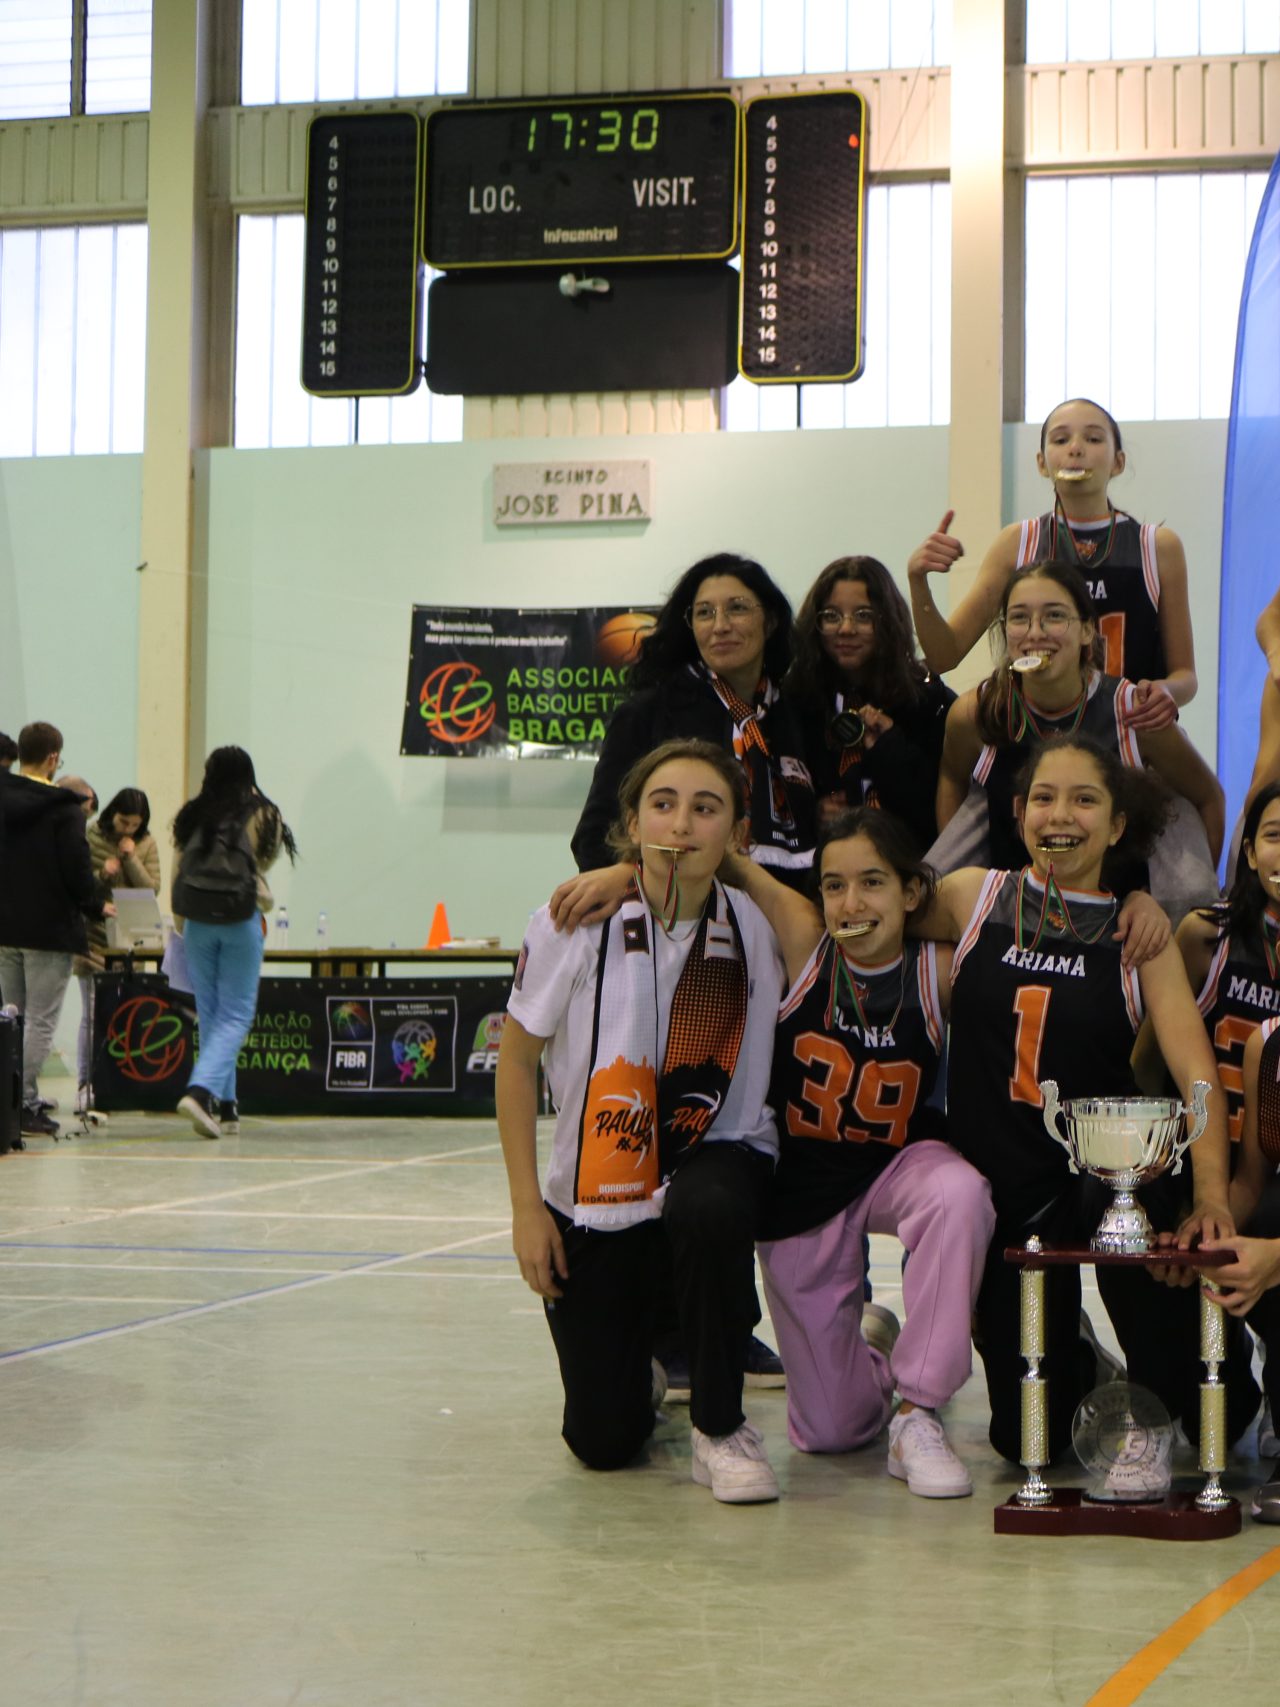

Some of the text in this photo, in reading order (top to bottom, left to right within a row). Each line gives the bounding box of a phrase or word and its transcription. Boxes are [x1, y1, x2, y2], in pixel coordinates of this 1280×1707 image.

[766, 115, 777, 130] 4
[528, 110, 659, 152] 17:30
[329, 136, 338, 149] 4
[766, 136, 777, 152] 5
[329, 156, 338, 170] 5
[765, 157, 776, 173] 6
[328, 176, 337, 190] 6
[765, 178, 776, 194] 7
[469, 185, 521, 214] LOC.
[633, 177, 697, 207] VISIT.
[328, 197, 337, 211] 7
[764, 199, 775, 215] 8
[327, 217, 336, 232] 8
[764, 220, 775, 236] 9
[326, 237, 336, 252] 9
[760, 241, 778, 257] 10
[322, 258, 339, 272] 10
[760, 262, 777, 278] 11
[322, 279, 337, 293] 11
[759, 283, 777, 299] 12
[322, 299, 337, 314] 12
[759, 304, 777, 321] 13
[320, 320, 336, 334] 13
[758, 325, 776, 342] 14
[320, 340, 336, 355] 14
[758, 347, 776, 364] 15
[319, 361, 335, 376] 15
[1001, 944, 1086, 977] ARIANA
[1008, 984, 1052, 1109] 1
[336, 1051, 366, 1068] FIBA
[786, 1031, 922, 1148] 39
